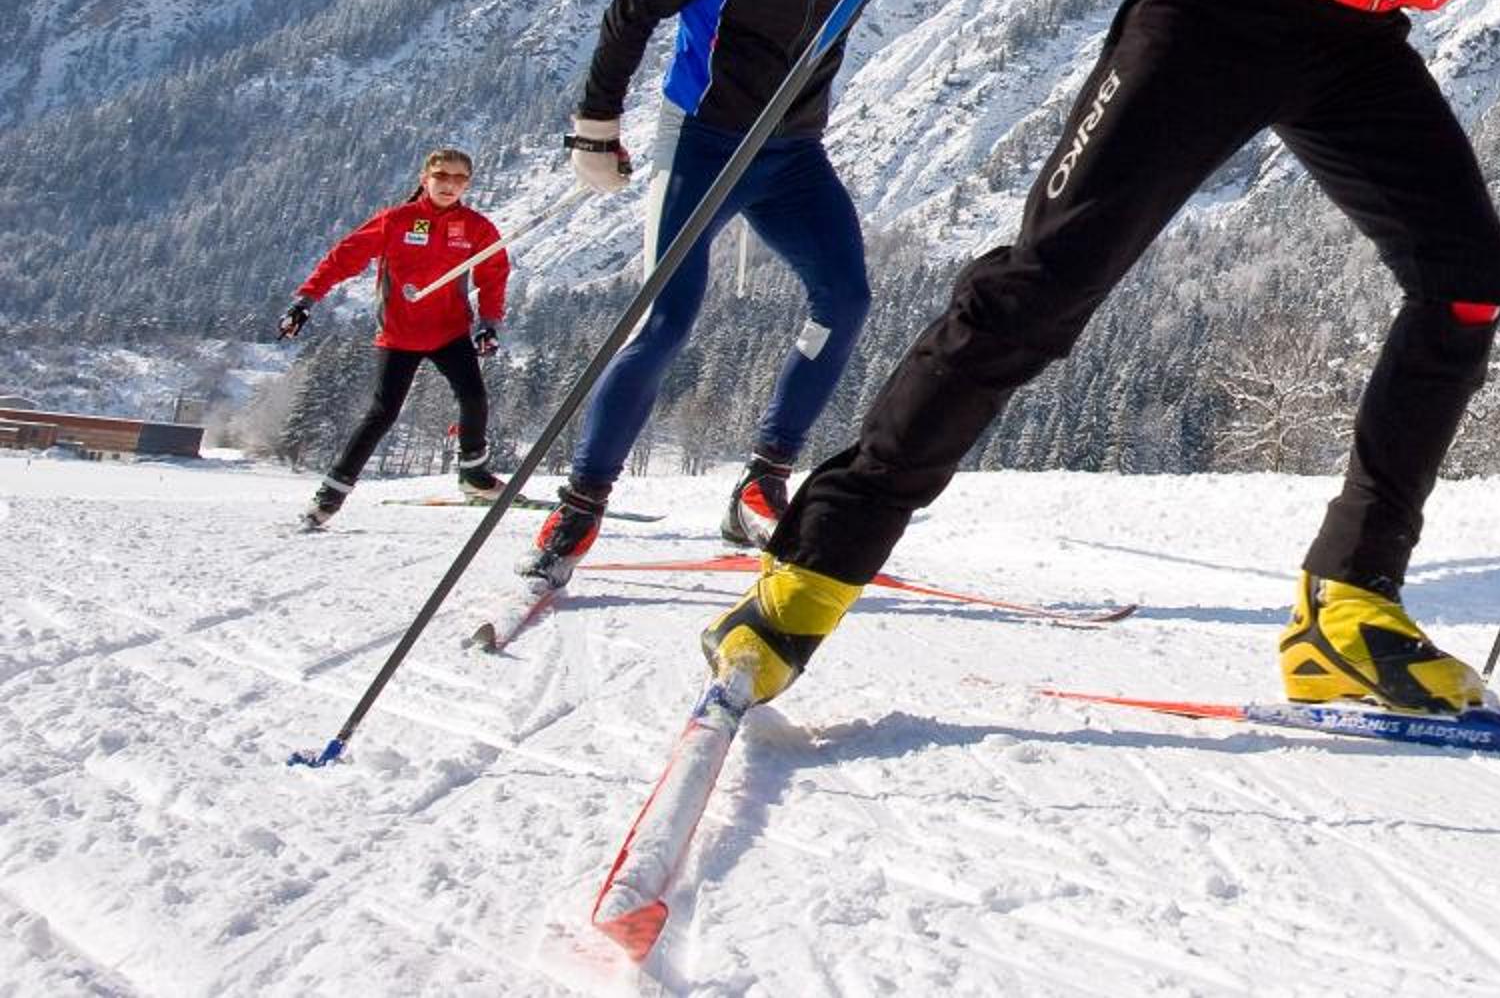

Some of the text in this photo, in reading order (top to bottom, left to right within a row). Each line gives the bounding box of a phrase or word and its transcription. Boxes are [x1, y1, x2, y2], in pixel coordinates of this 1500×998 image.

[1047, 69, 1121, 199] BRIKO
[1322, 713, 1492, 744] MADSHUS MADSHUS
